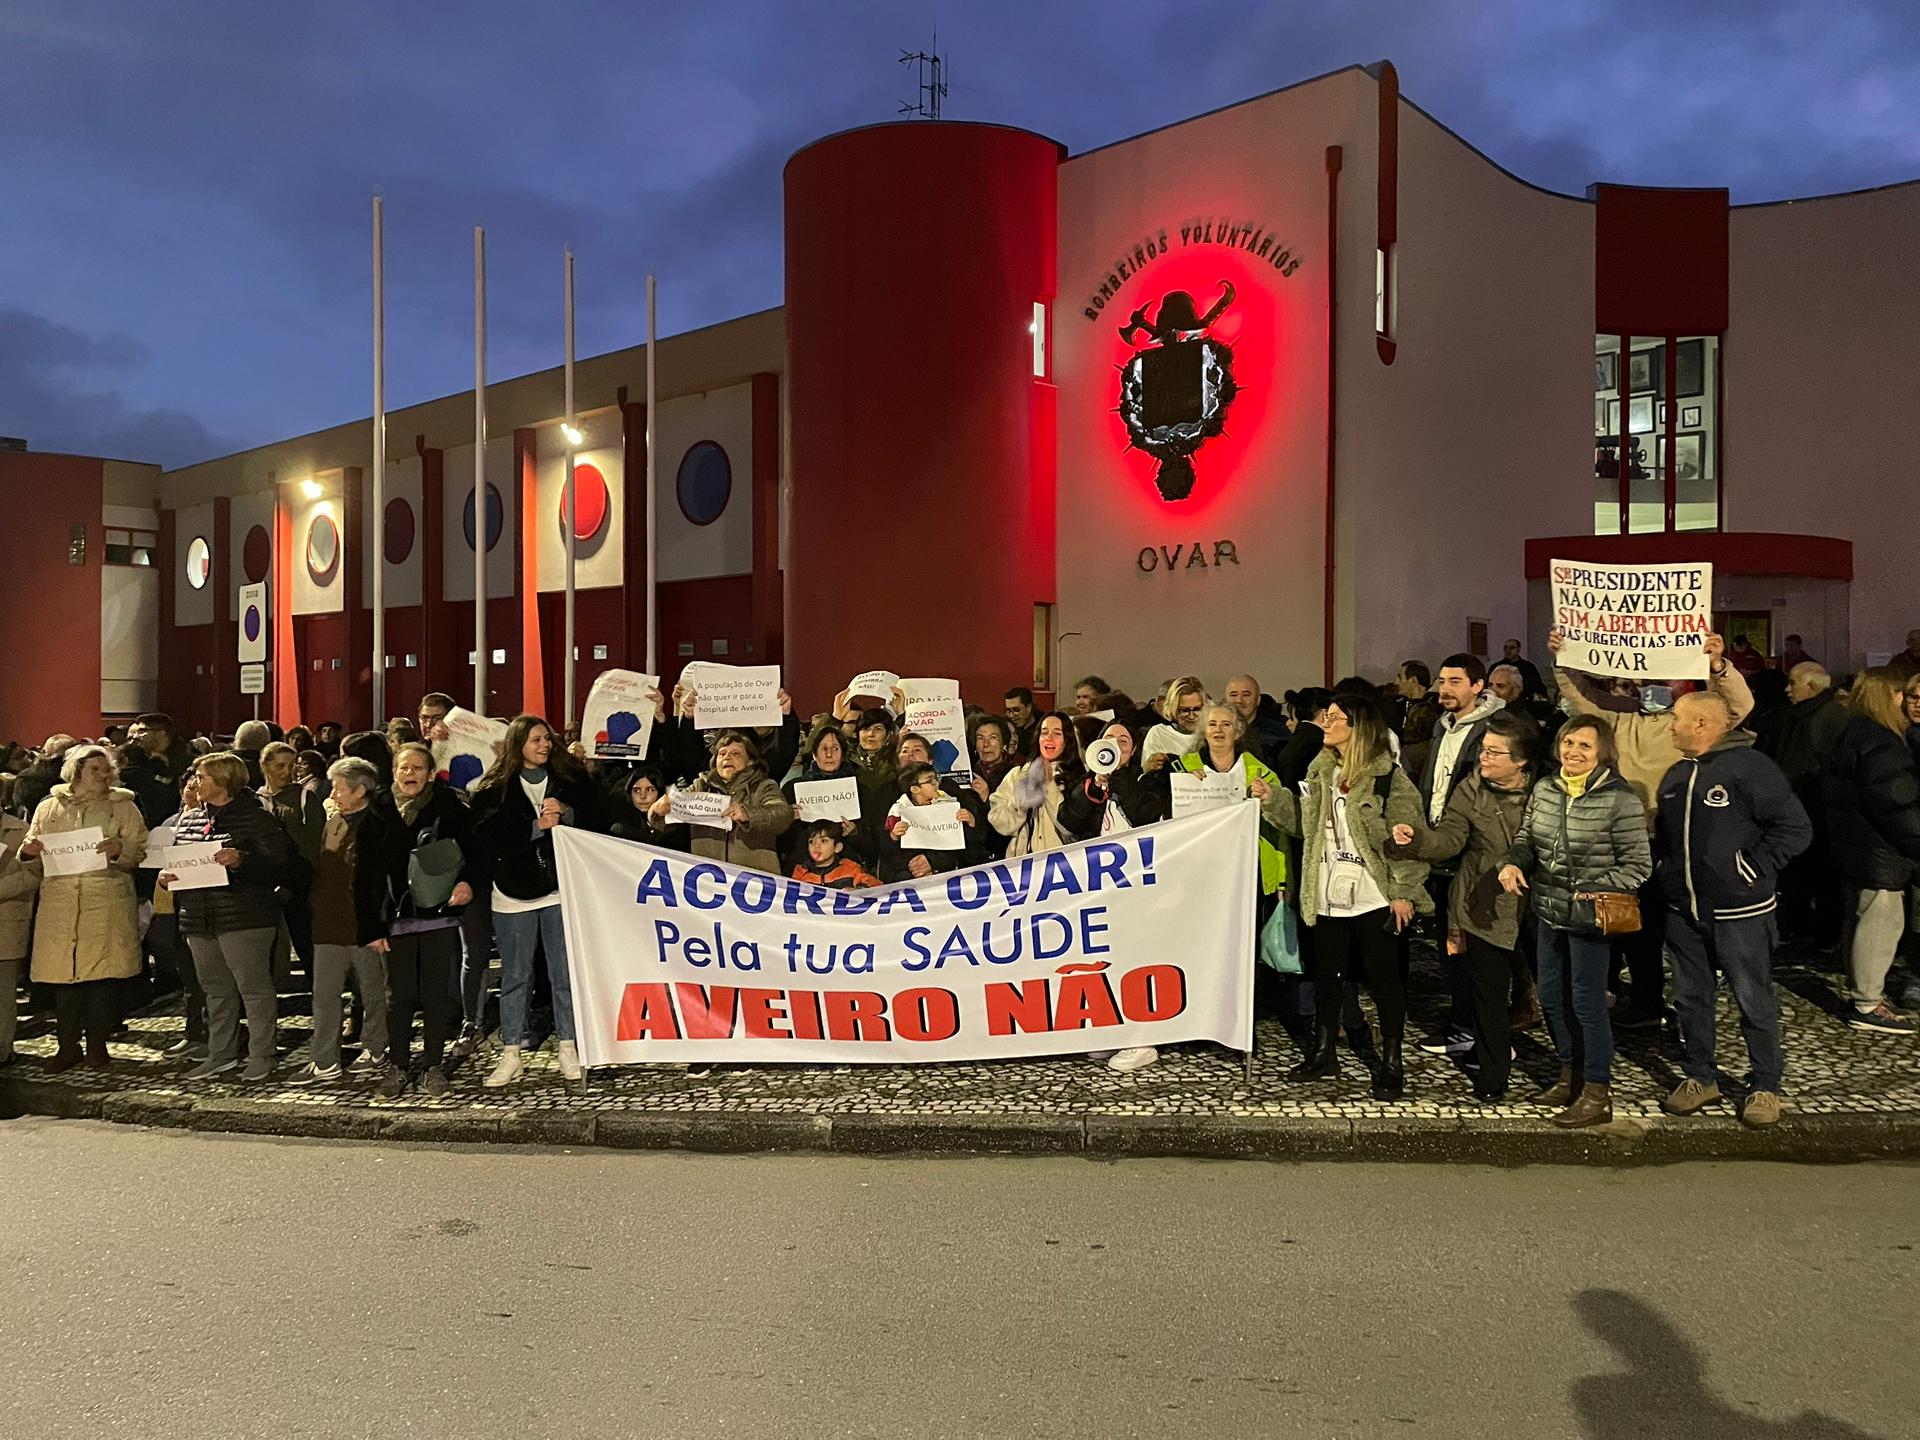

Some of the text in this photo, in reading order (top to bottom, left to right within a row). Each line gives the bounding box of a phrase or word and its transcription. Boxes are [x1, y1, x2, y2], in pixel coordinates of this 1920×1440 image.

[1085, 224, 1299, 322] BOMBEIROS VOLUNTÁRIOS
[1137, 539, 1240, 572] OVAR
[1572, 568, 1702, 591] PRESIDENTE
[1589, 648, 1648, 671] OVAR
[705, 681, 743, 689] população
[713, 694, 731, 702] quer
[740, 693, 757, 701] para
[698, 705, 728, 713] hospital
[740, 703, 767, 712] Aveiro!
[908, 710, 946, 719] ACORDA
[688, 803, 704, 811] NÃO
[800, 791, 855, 805] AVEIRO NÃO!
[43, 846, 74, 855] AVEIRO
[636, 836, 1158, 916] ACORDA OVAR!
[654, 906, 1111, 974] Pela tua SAÚDE
[616, 961, 1188, 1042] AVEIRO NÃO
